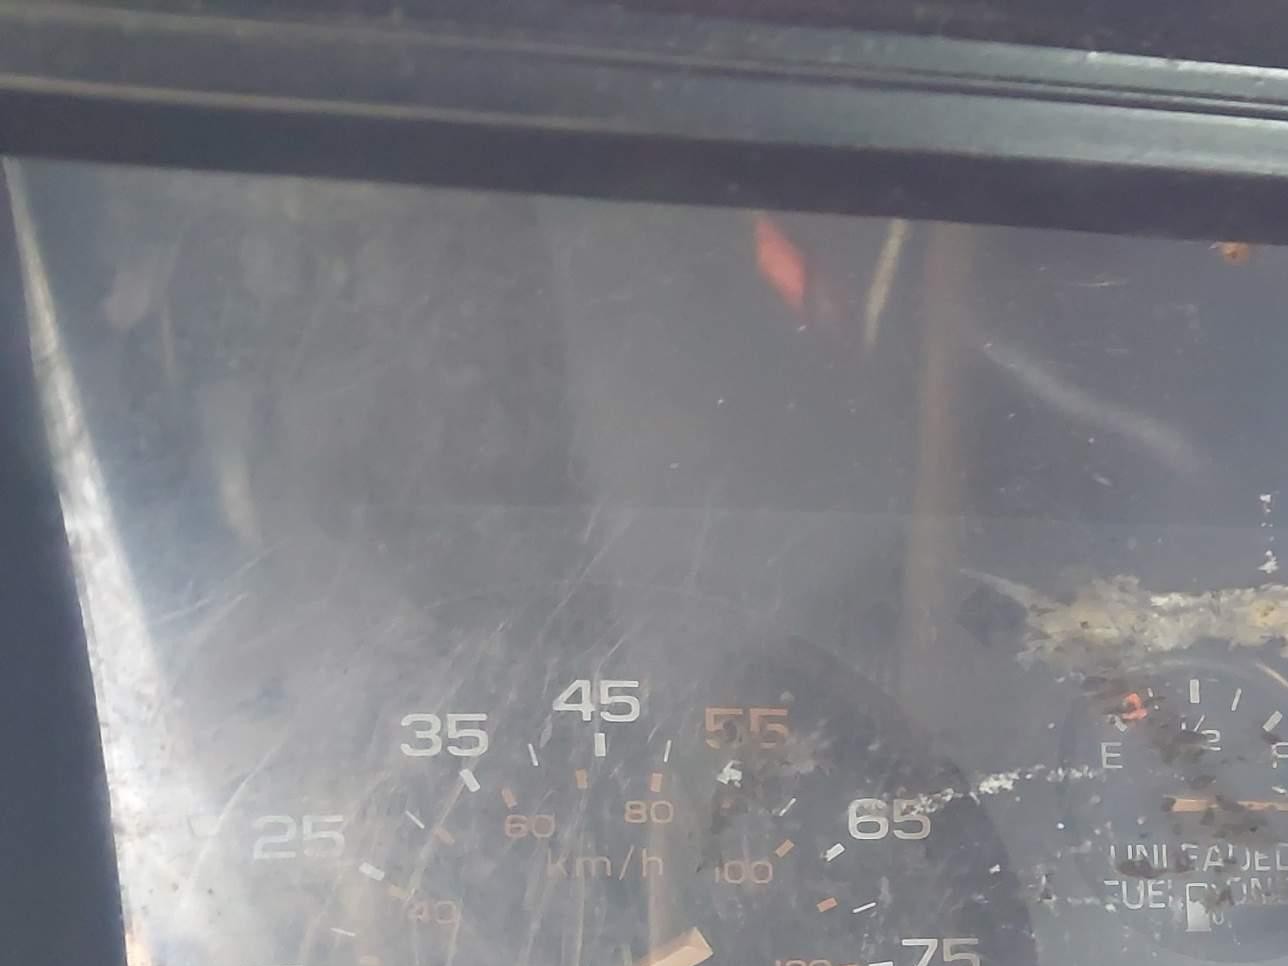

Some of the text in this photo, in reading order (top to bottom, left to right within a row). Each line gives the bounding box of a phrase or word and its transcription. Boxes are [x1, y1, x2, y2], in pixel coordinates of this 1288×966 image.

[552, 680, 641, 722] 45
[400, 713, 489, 757] 35
[704, 707, 788, 750] 55
[1101, 742, 1123, 769] E
[504, 815, 556, 838] 60
[624, 801, 674, 823] 80
[848, 798, 931, 840] 65
[253, 815, 345, 859] 25
[547, 848, 665, 880] km/h
[714, 860, 773, 884] 100
